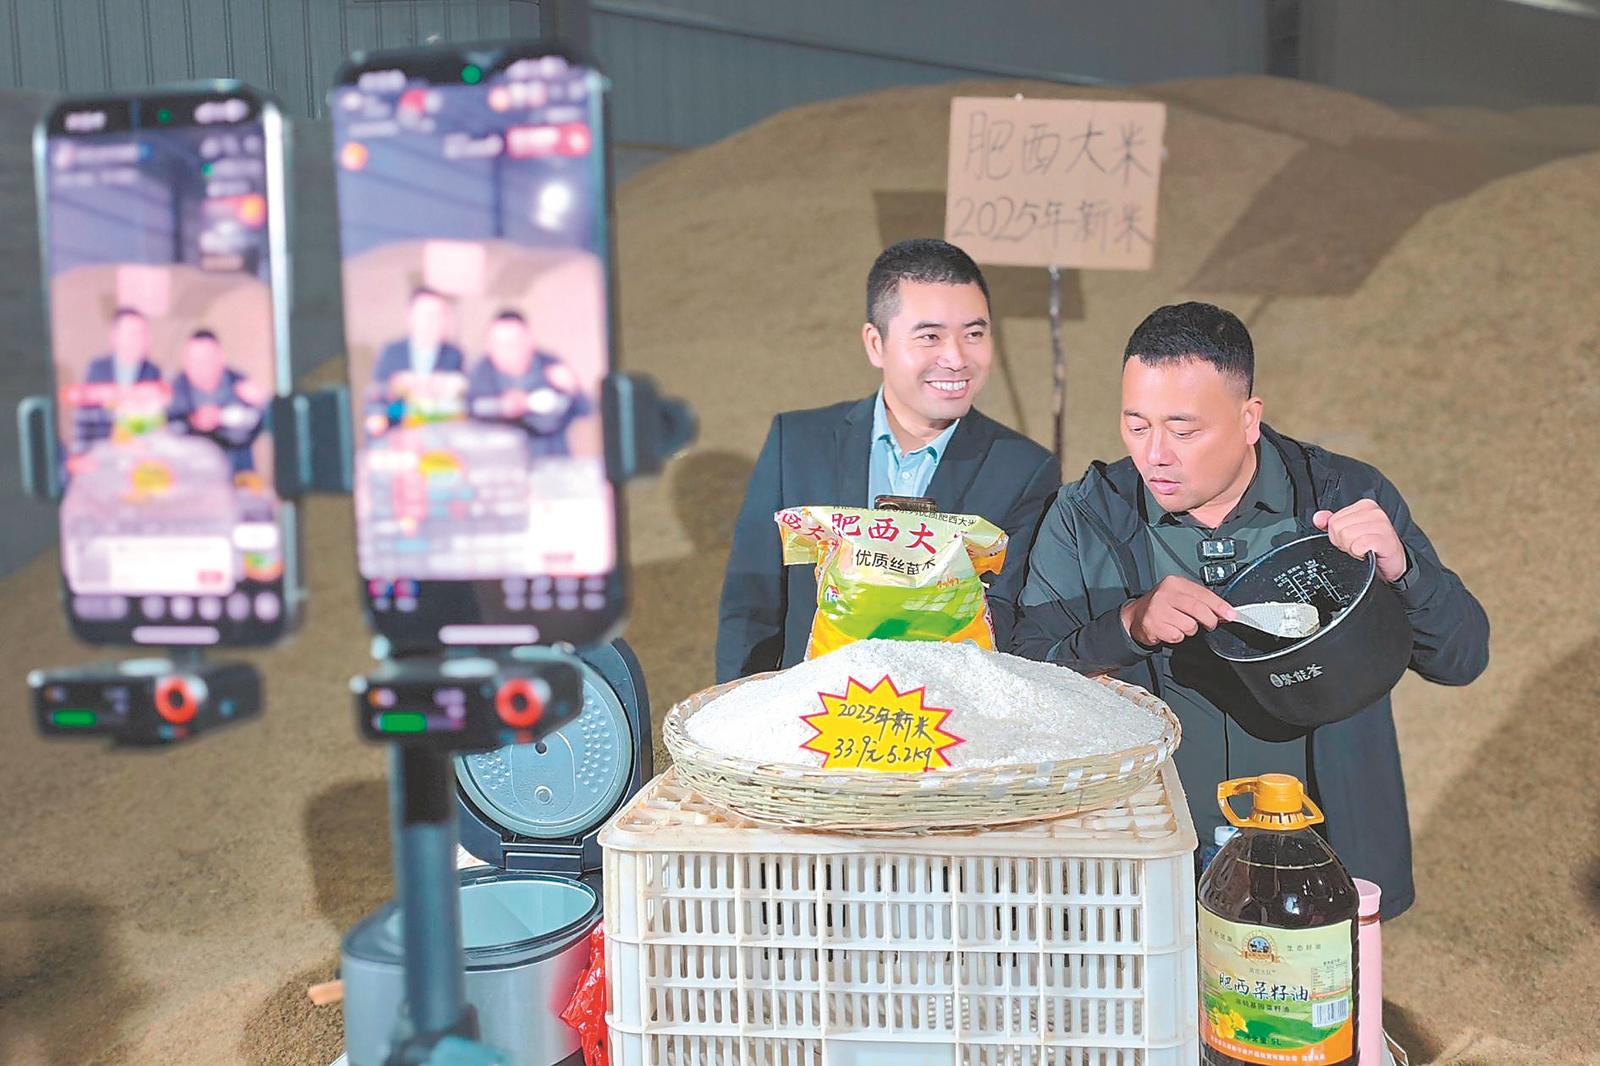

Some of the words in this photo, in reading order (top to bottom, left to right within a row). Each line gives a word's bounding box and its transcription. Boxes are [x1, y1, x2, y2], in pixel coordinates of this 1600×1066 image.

[964, 110, 1151, 186] 肥西大米
[954, 196, 1154, 253] 2025年新米
[831, 513, 968, 555] 肥西大
[838, 703, 935, 744] 2025年新米
[1219, 971, 1309, 1002] 肥西菜籽油
